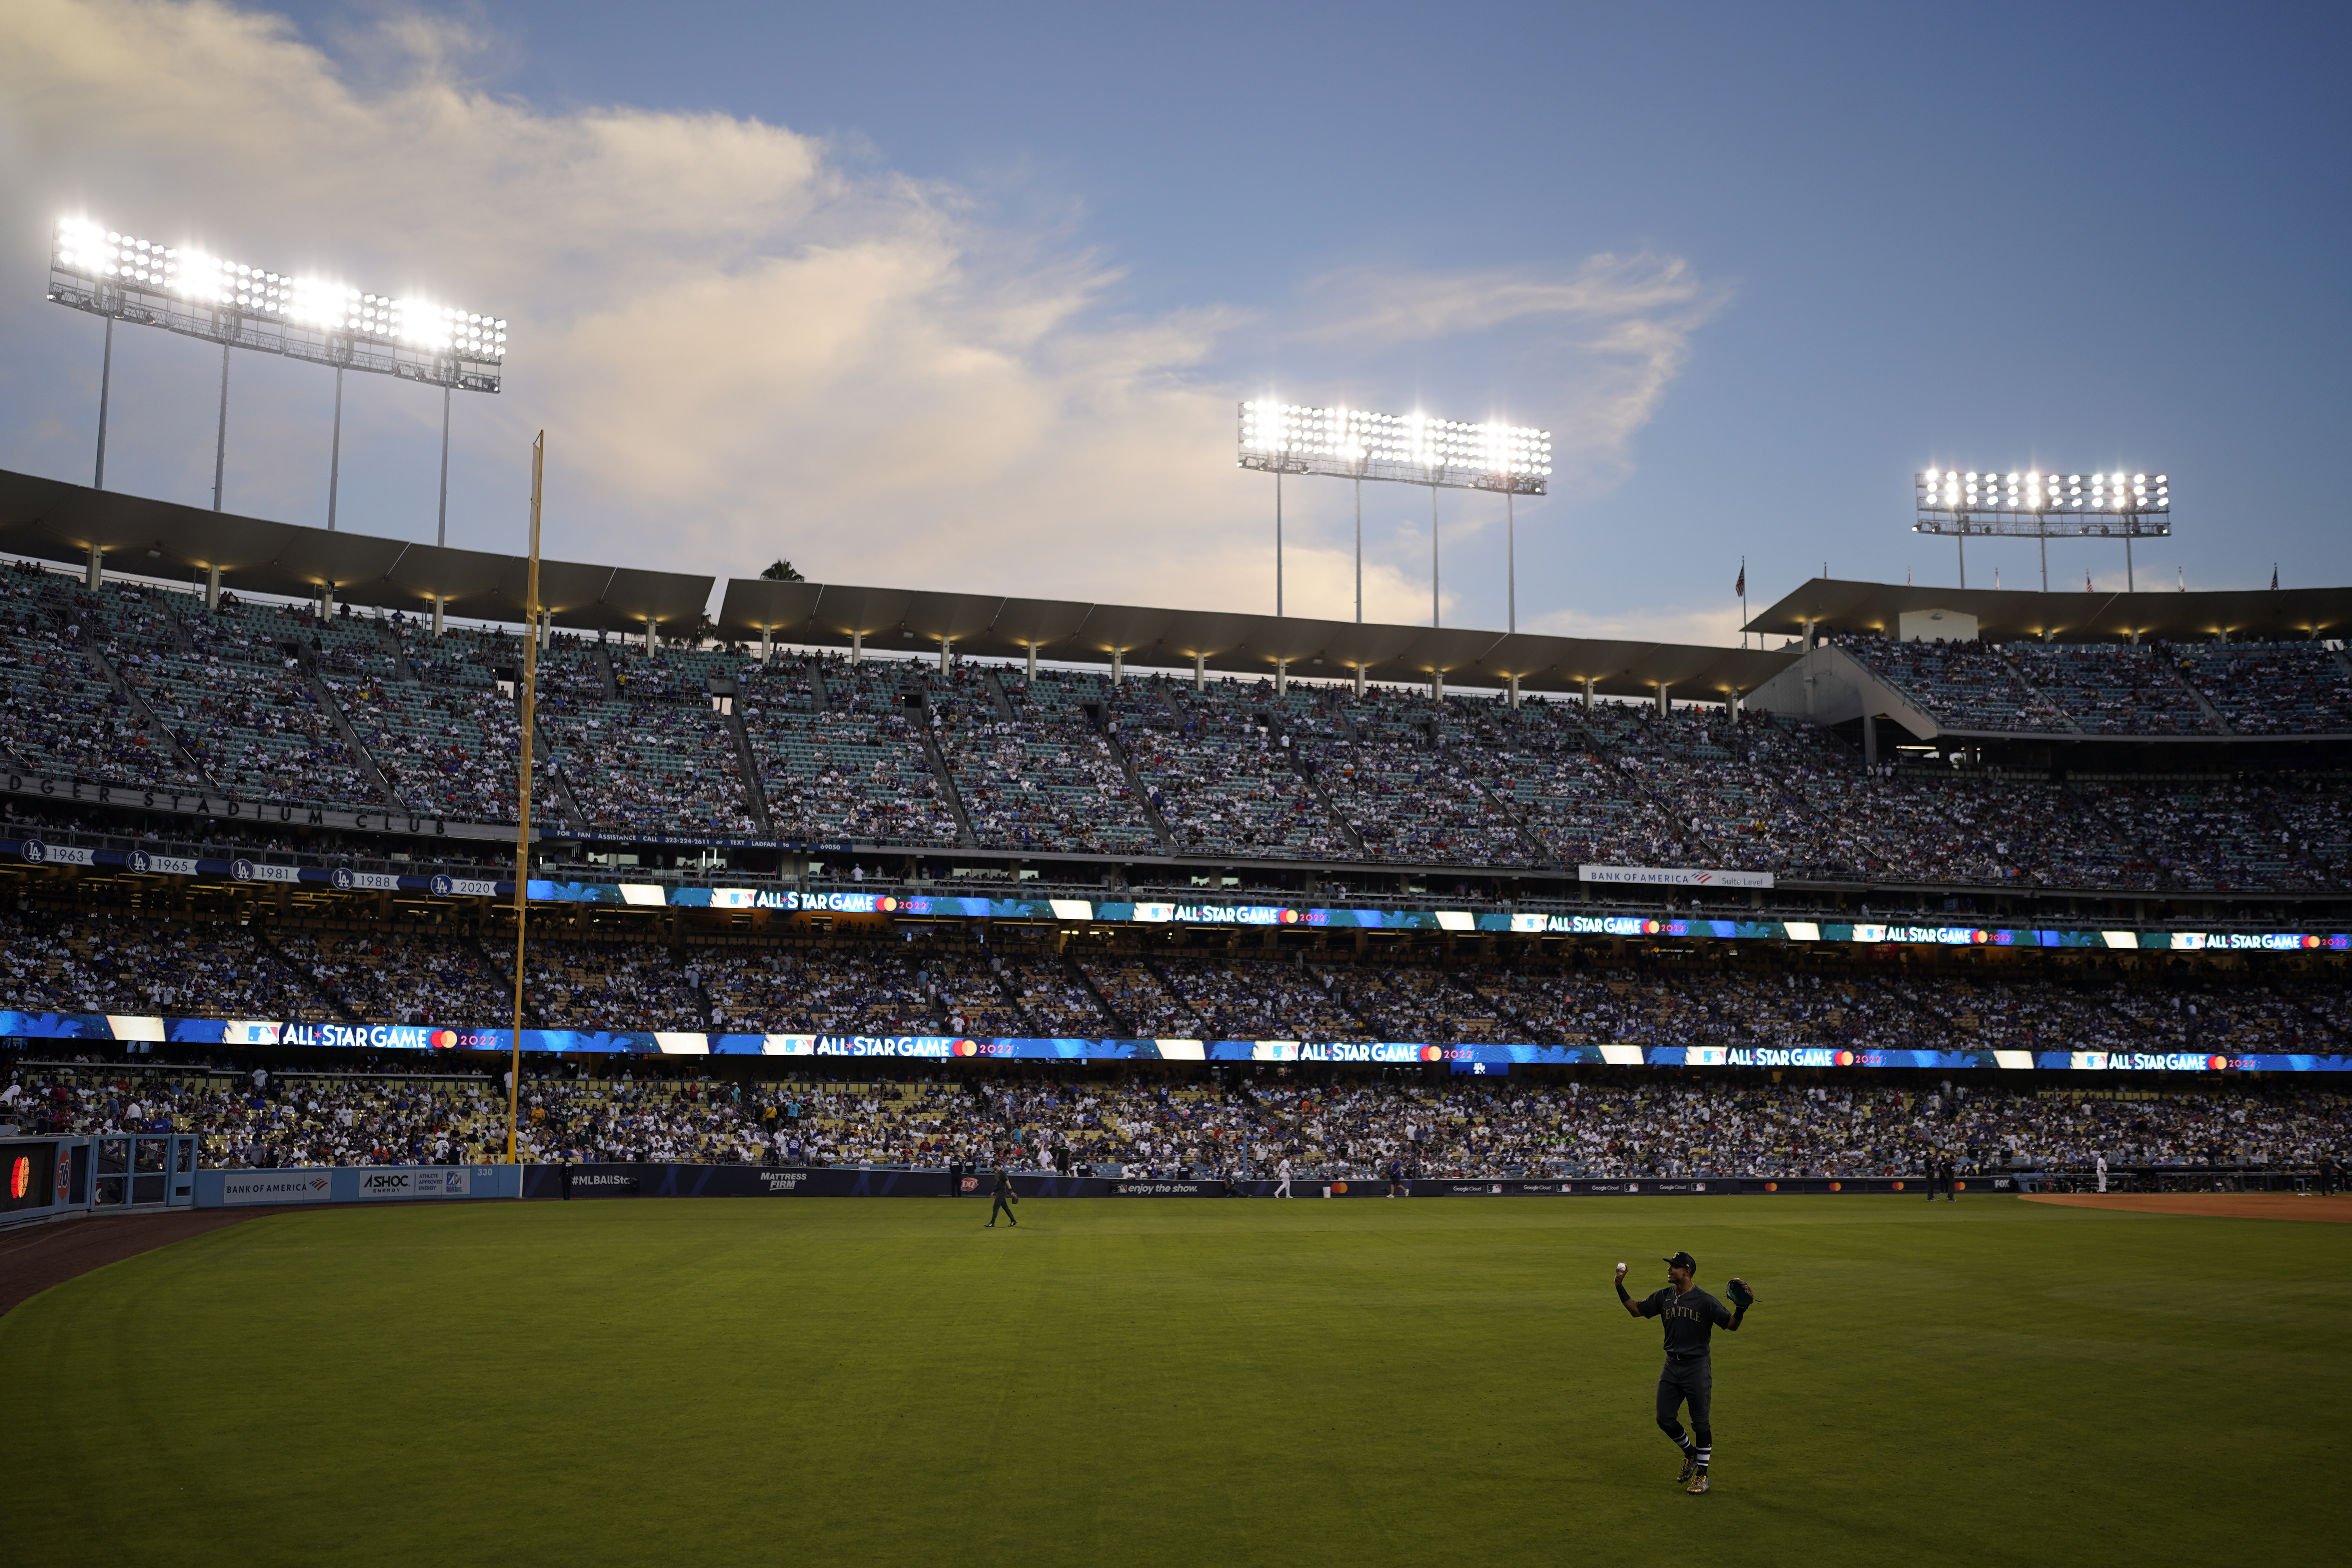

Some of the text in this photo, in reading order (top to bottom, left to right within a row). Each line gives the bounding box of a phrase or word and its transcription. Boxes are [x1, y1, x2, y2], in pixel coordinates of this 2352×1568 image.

[144, 793, 323, 825] STADIUM
[356, 815, 445, 835] CLUB
[53, 848, 84, 862] 1963
[157, 858, 188, 872] 1965
[260, 867, 289, 880] 1981
[1591, 872, 1621, 881] BANK
[1640, 874, 1689, 884] AMERICA
[1722, 877, 1741, 886] Suite
[1743, 878, 1763, 886] Level
[360, 875, 390, 887] 1988
[460, 882, 490, 893] 2020
[829, 893, 873, 911] GAME
[899, 901, 927, 910] 2022
[1236, 906, 1277, 924] GAME
[1299, 914, 1325, 922] 2022
[1604, 917, 1641, 933] GAME
[1937, 927, 1971, 944] GAME
[2261, 934, 2300, 949] GAME
[370, 1026, 427, 1049] GAME
[460, 1035, 495, 1046] 2022
[898, 1038, 949, 1057] GAME
[979, 1044, 1012, 1054] 2022
[1371, 1044, 1417, 1062] GAME
[1444, 1050, 1473, 1059] 2022
[1791, 1049, 1832, 1067] GAME
[1855, 1055, 1881, 1063] 2022
[2166, 1054, 2206, 1071] GAME
[2228, 1060, 2255, 1068] 2022
[58, 1159, 69, 1189] 76
[364, 1174, 409, 1188] ASHOC
[572, 1175, 632, 1186] #MLBAllSta
[760, 1172, 808, 1181] MATTRESS
[227, 1185, 250, 1194] BANK
[267, 1183, 307, 1192] AMERICA
[1128, 1183, 1198, 1194] enjoy the show.
[1994, 1179, 2010, 1188] FOX
